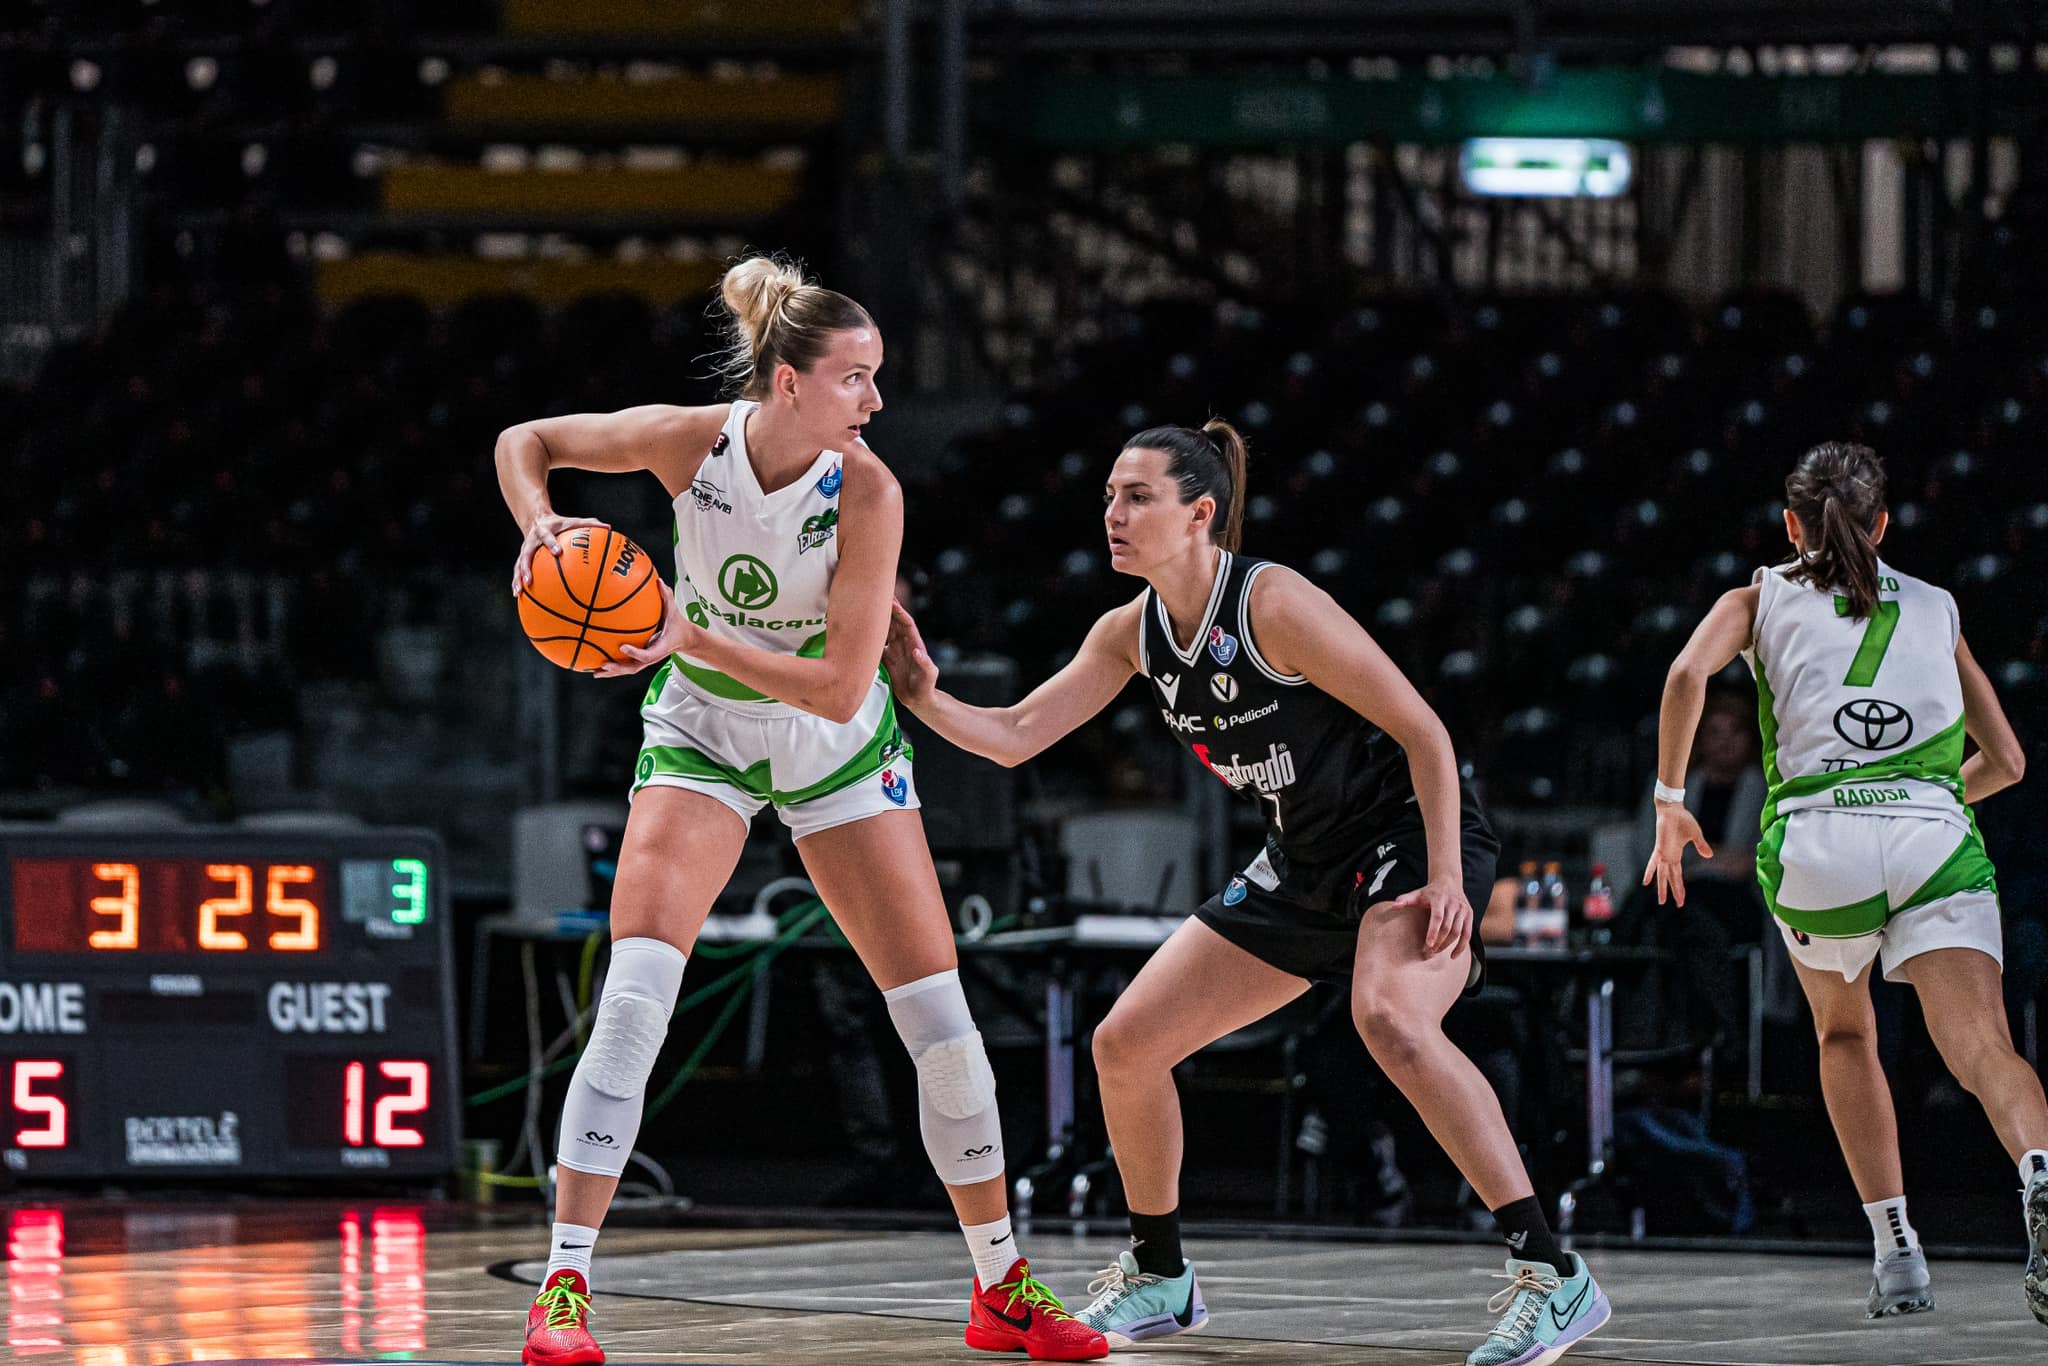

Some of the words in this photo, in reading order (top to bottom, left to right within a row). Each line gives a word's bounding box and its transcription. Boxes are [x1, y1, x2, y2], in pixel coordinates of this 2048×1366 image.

[1833, 593, 1901, 688] 7
[1161, 708, 1206, 733] FAAC
[1229, 700, 1280, 727] Pelliconi
[1833, 788, 1912, 808] RAGUSA
[89, 863, 140, 950] 3
[198, 864, 319, 951] 25
[391, 858, 428, 924] 3
[267, 981, 391, 1034] GUEST
[343, 1060, 430, 1147] 12
